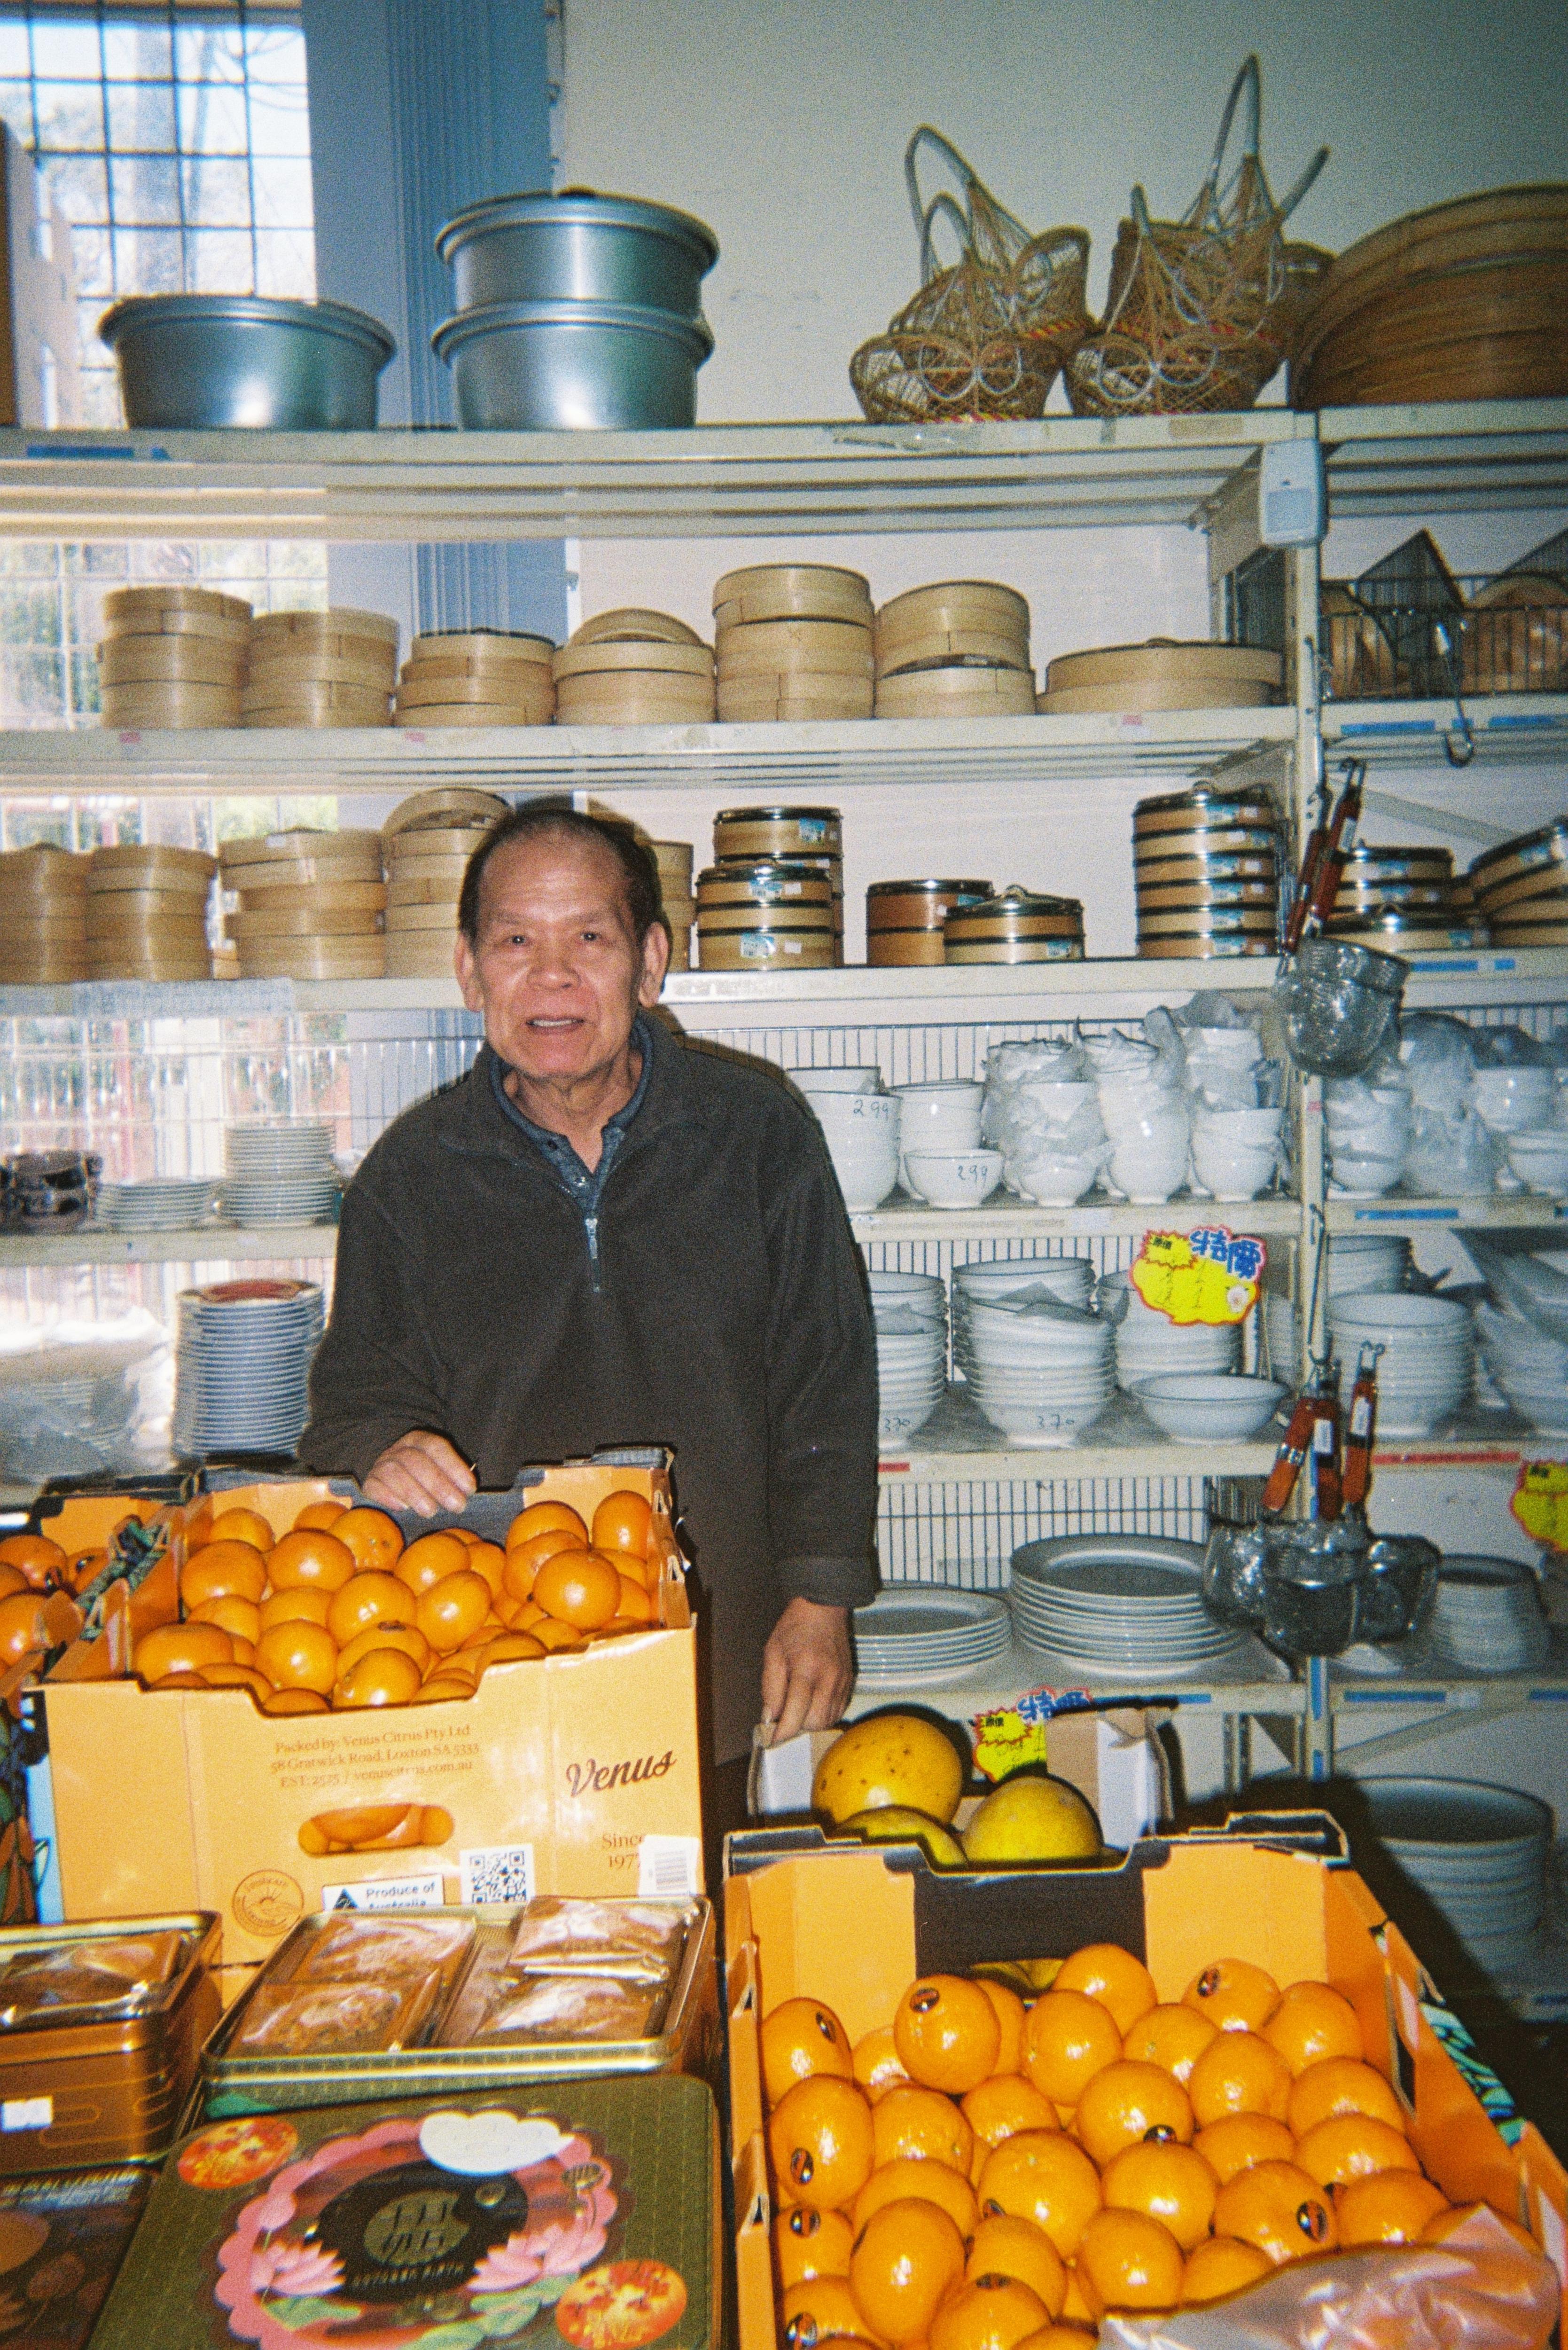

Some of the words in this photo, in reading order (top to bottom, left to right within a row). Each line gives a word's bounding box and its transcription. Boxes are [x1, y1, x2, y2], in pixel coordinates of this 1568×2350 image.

[1189, 1229, 1262, 1279] 特價
[275, 1738, 320, 1754] Packed
[343, 1736, 380, 1747] Venus
[382, 1731, 422, 1743] Citrus
[425, 1728, 445, 1741] Pty
[448, 1724, 470, 1736] Ltd
[287, 1754, 346, 1770] Gratwick
[386, 1747, 431, 1760] Loxton
[433, 1744, 451, 1755] SA
[453, 1743, 479, 1757] 5333
[566, 1750, 677, 1798] Venus
[366, 1886, 419, 1898] Produce
[423, 1881, 435, 1893] of
